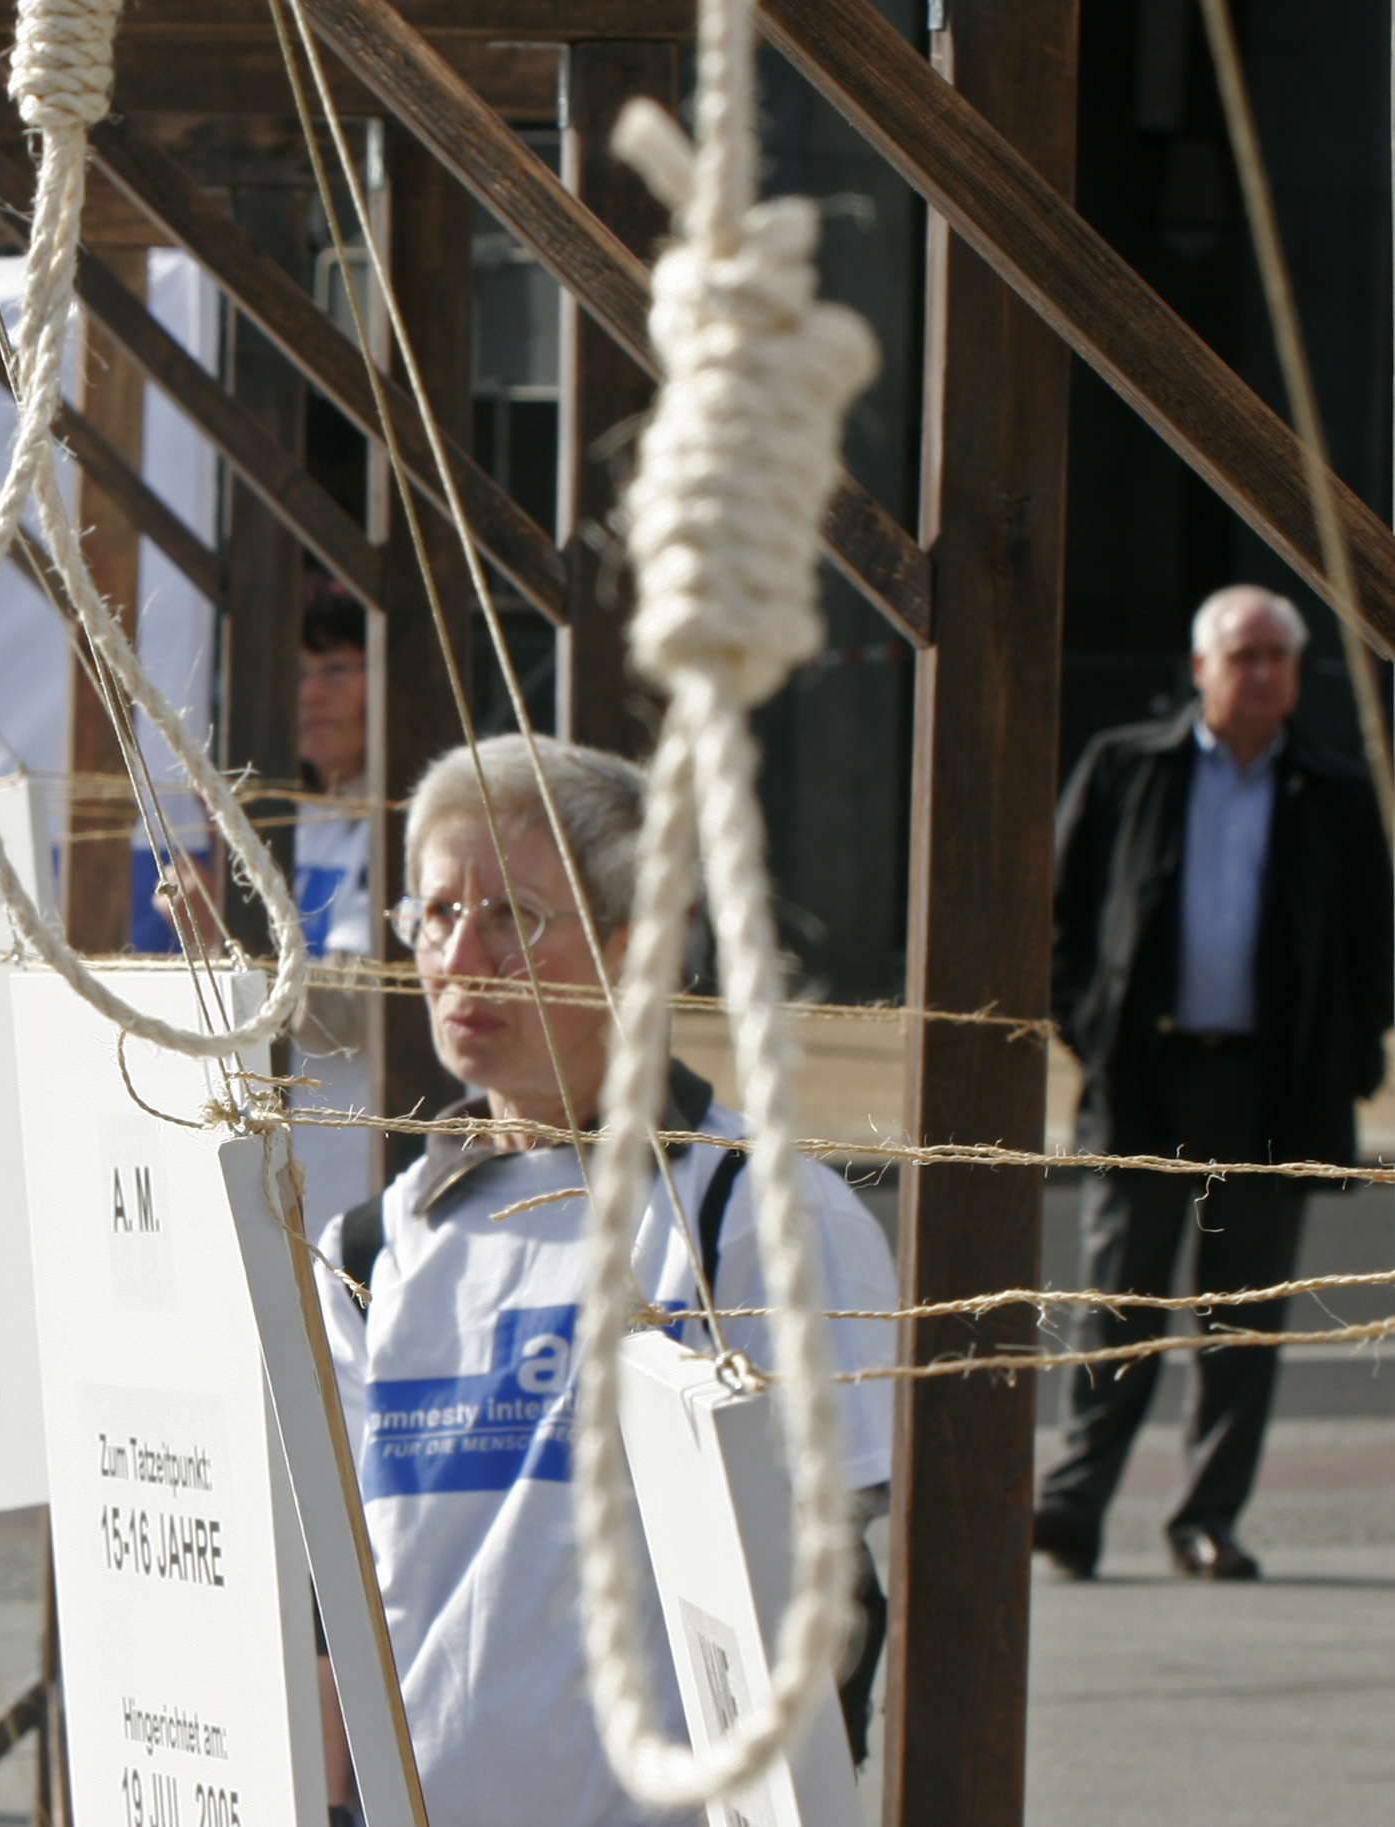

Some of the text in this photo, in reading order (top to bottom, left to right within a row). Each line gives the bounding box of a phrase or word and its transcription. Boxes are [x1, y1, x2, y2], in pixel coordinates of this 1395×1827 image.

[368, 1402, 480, 1431] amnesty
[99, 1433, 129, 1480] Zum
[101, 1505, 225, 1588] 15-16 JAHRE
[122, 1696, 202, 1756] Hingerichtet
